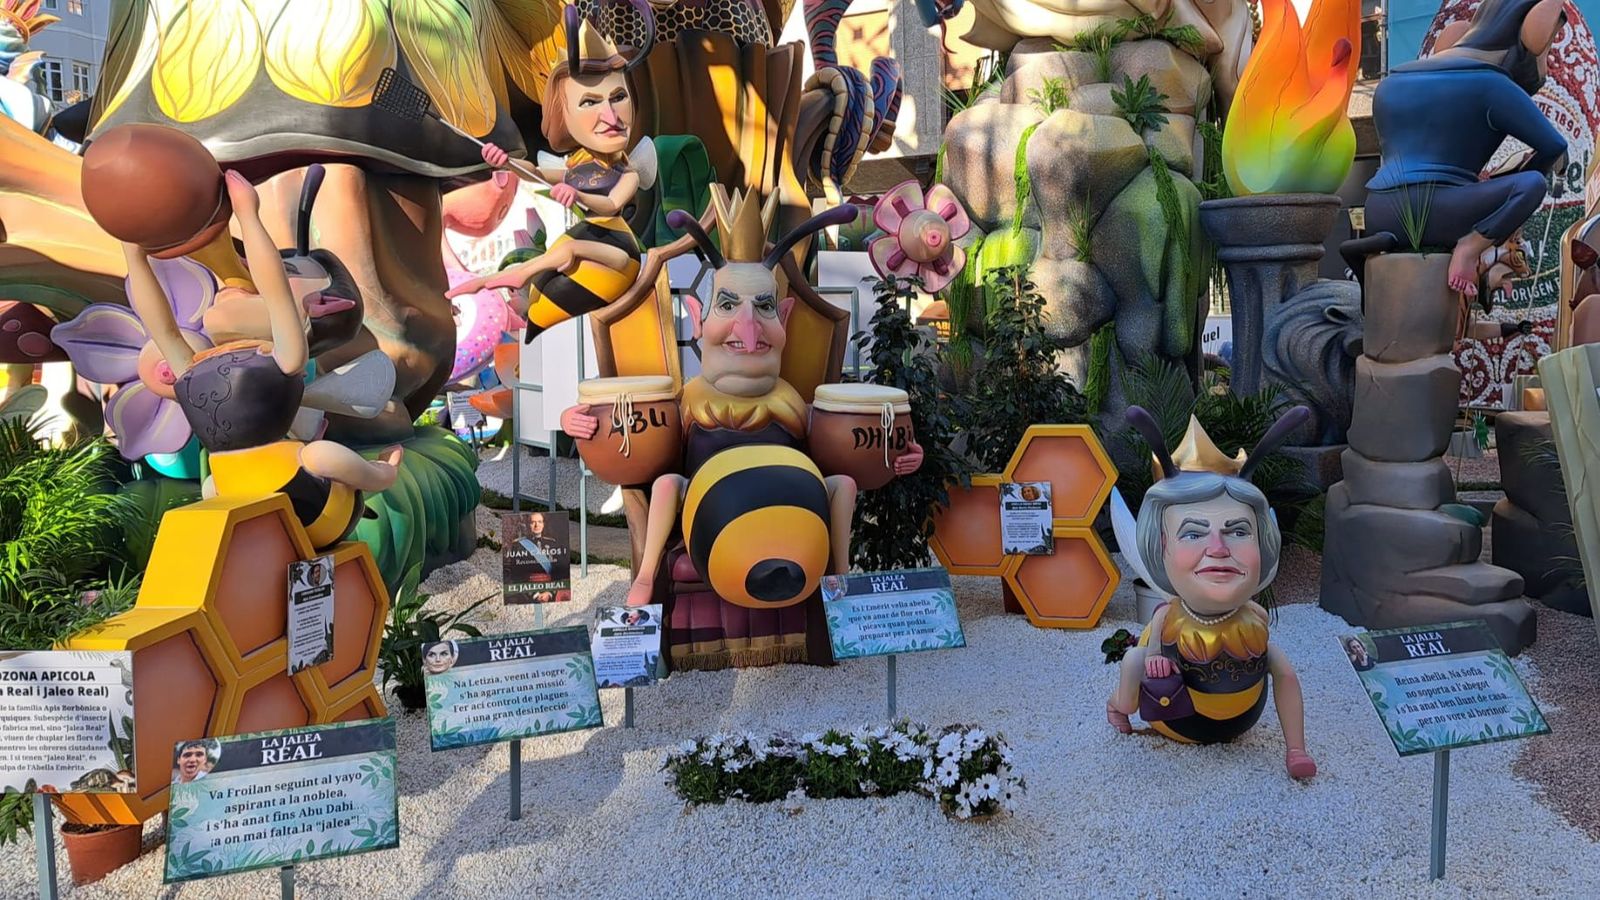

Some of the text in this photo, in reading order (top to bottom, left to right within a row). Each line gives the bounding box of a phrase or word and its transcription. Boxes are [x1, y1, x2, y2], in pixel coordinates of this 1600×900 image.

[1554, 110, 1581, 139] 1890
[1511, 281, 1554, 301] ORIGEN
[520, 583, 544, 592] JALEO
[872, 580, 908, 592] REAL
[887, 621, 906, 629] quan
[892, 630, 904, 638] per
[1400, 632, 1443, 644] LA JALEA
[488, 637, 534, 649] LA JALEA
[1404, 642, 1451, 658] REAL
[489, 645, 536, 662] REAL
[0, 671, 96, 681] ZONA APICOLA
[454, 680, 466, 688] Na
[468, 676, 503, 688] Letizia,
[504, 673, 528, 682] veent
[531, 670, 540, 679] al
[1394, 676, 1420, 686] Reina
[1421, 672, 1450, 682] abella,
[1448, 669, 1462, 678] Na
[7, 686, 33, 696] Real
[36, 686, 40, 696] i
[42, 686, 74, 698] Jaleo
[78, 686, 109, 698] Real)
[460, 690, 479, 700] s'ha
[480, 686, 515, 698] agarrat
[516, 684, 534, 692] una
[1418, 686, 1450, 698] soporta
[1456, 680, 1490, 692] l'abegot
[44, 704, 60, 712] Apis
[454, 704, 469, 713] Fer
[470, 701, 485, 710] ací
[486, 696, 520, 708] control
[522, 694, 532, 704] de
[1396, 706, 1400, 714] i
[1401, 703, 1420, 714] s'ha
[1420, 700, 1440, 710] anat
[1439, 698, 1456, 708] ben
[1477, 693, 1488, 702] de
[473, 714, 491, 722] una
[492, 710, 514, 722] gran
[1446, 712, 1466, 721] vore
[1466, 708, 1475, 718] al
[36, 734, 63, 742] chuplar
[262, 733, 322, 748] LA JALEA
[260, 744, 322, 765] REAL
[209, 772, 362, 800] Va Froilan seguint al yayo
[224, 789, 347, 814] aspirant a la noblea,
[206, 822, 210, 832] i
[213, 818, 239, 832] s'ha
[242, 816, 270, 827] anat
[272, 811, 296, 822] fins
[298, 806, 323, 818] Abu
[210, 837, 221, 848] ¡a
[224, 834, 240, 844] on
[243, 830, 267, 843] mai
[270, 825, 298, 838] falta
[302, 822, 313, 833] la
